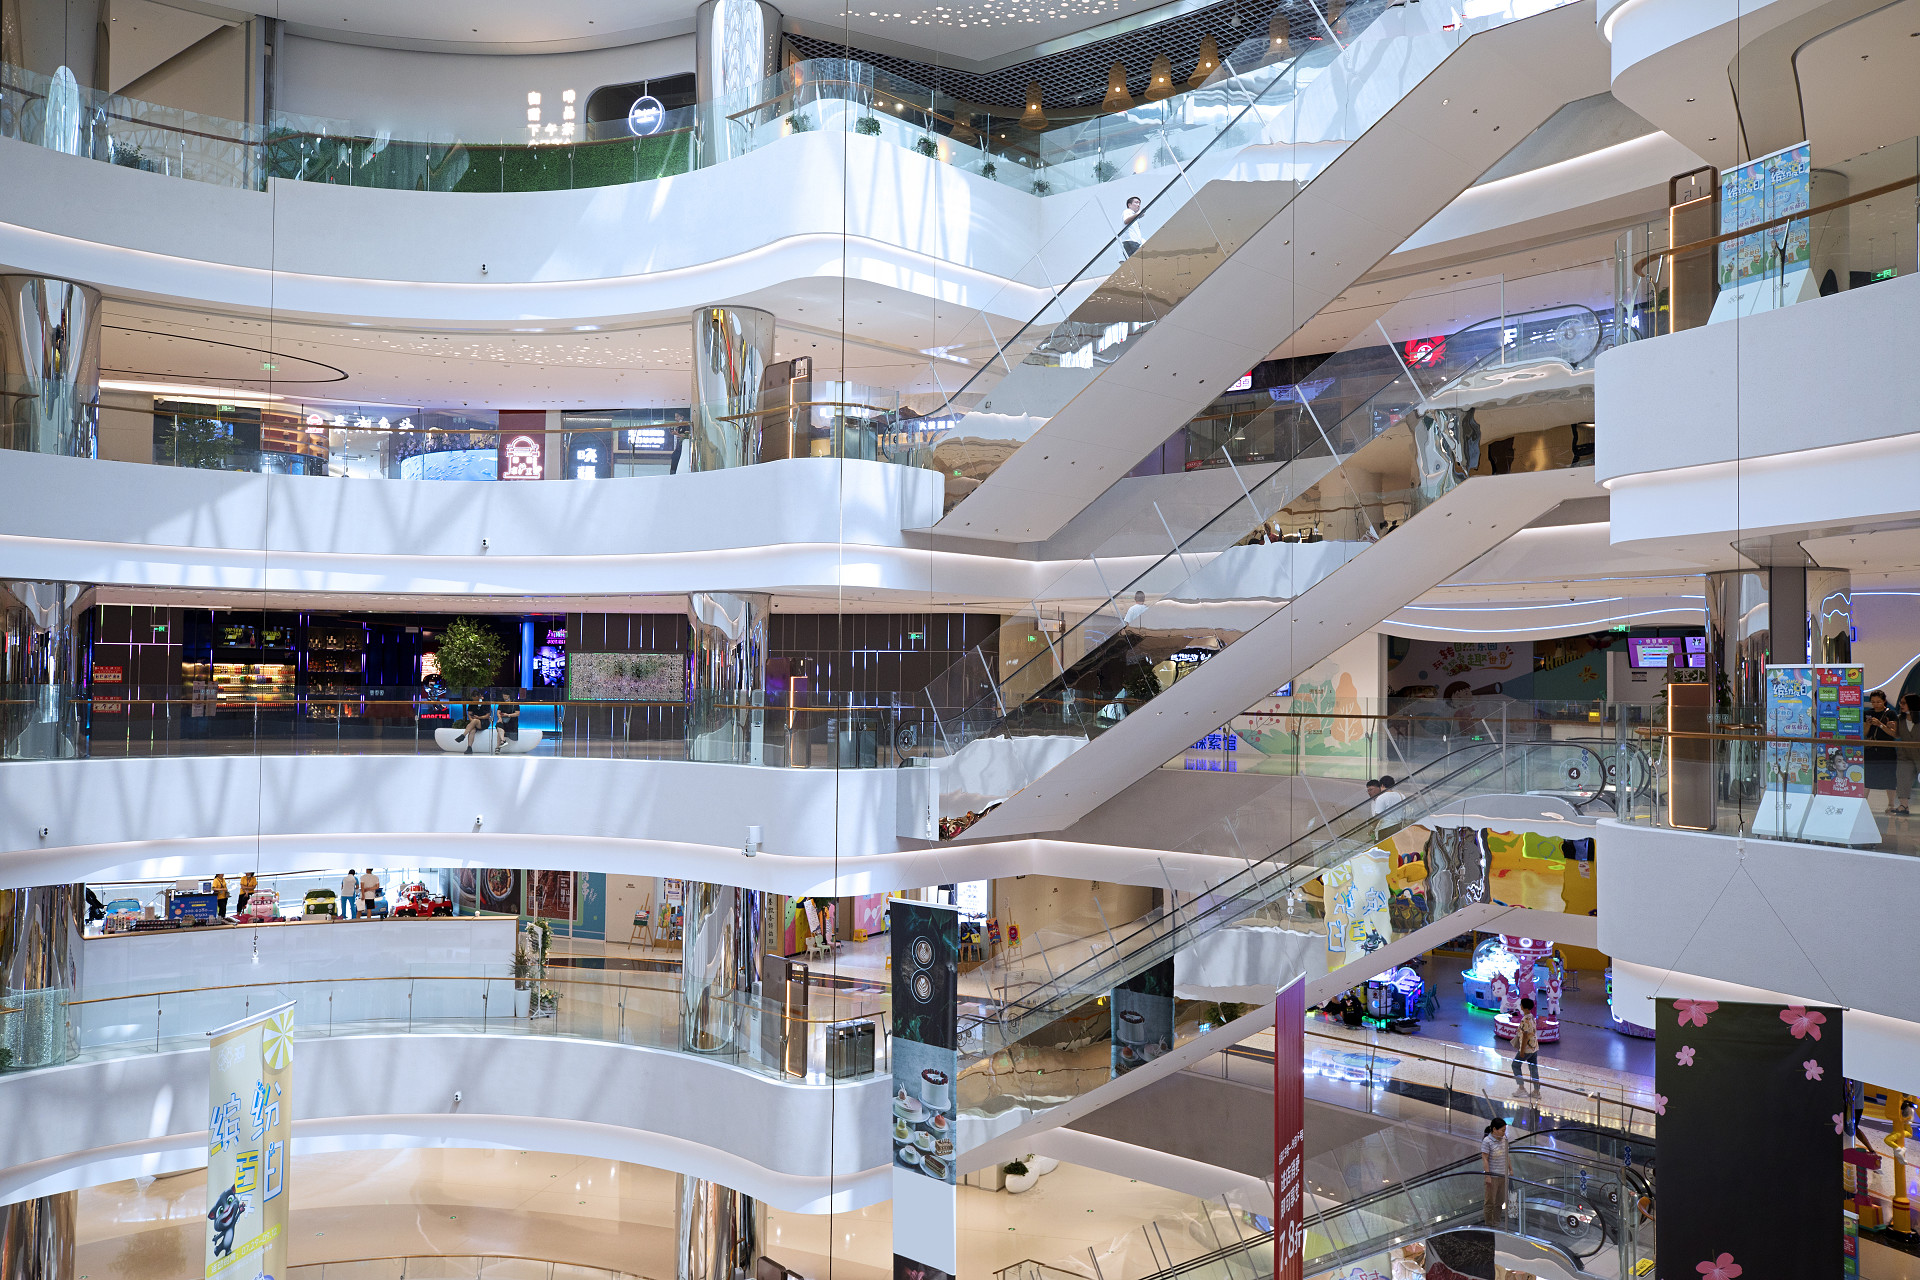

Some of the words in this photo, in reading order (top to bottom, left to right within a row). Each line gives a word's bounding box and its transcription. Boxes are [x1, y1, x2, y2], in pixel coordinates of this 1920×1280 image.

[1190, 733, 1238, 751] 探索馆
[1570, 769, 1578, 778] 4
[210, 1079, 281, 1157] 缤纷
[1611, 1193, 1617, 1202] 3
[1569, 1217, 1576, 1227] 3
[1279, 1219, 1302, 1273] 7.8折
